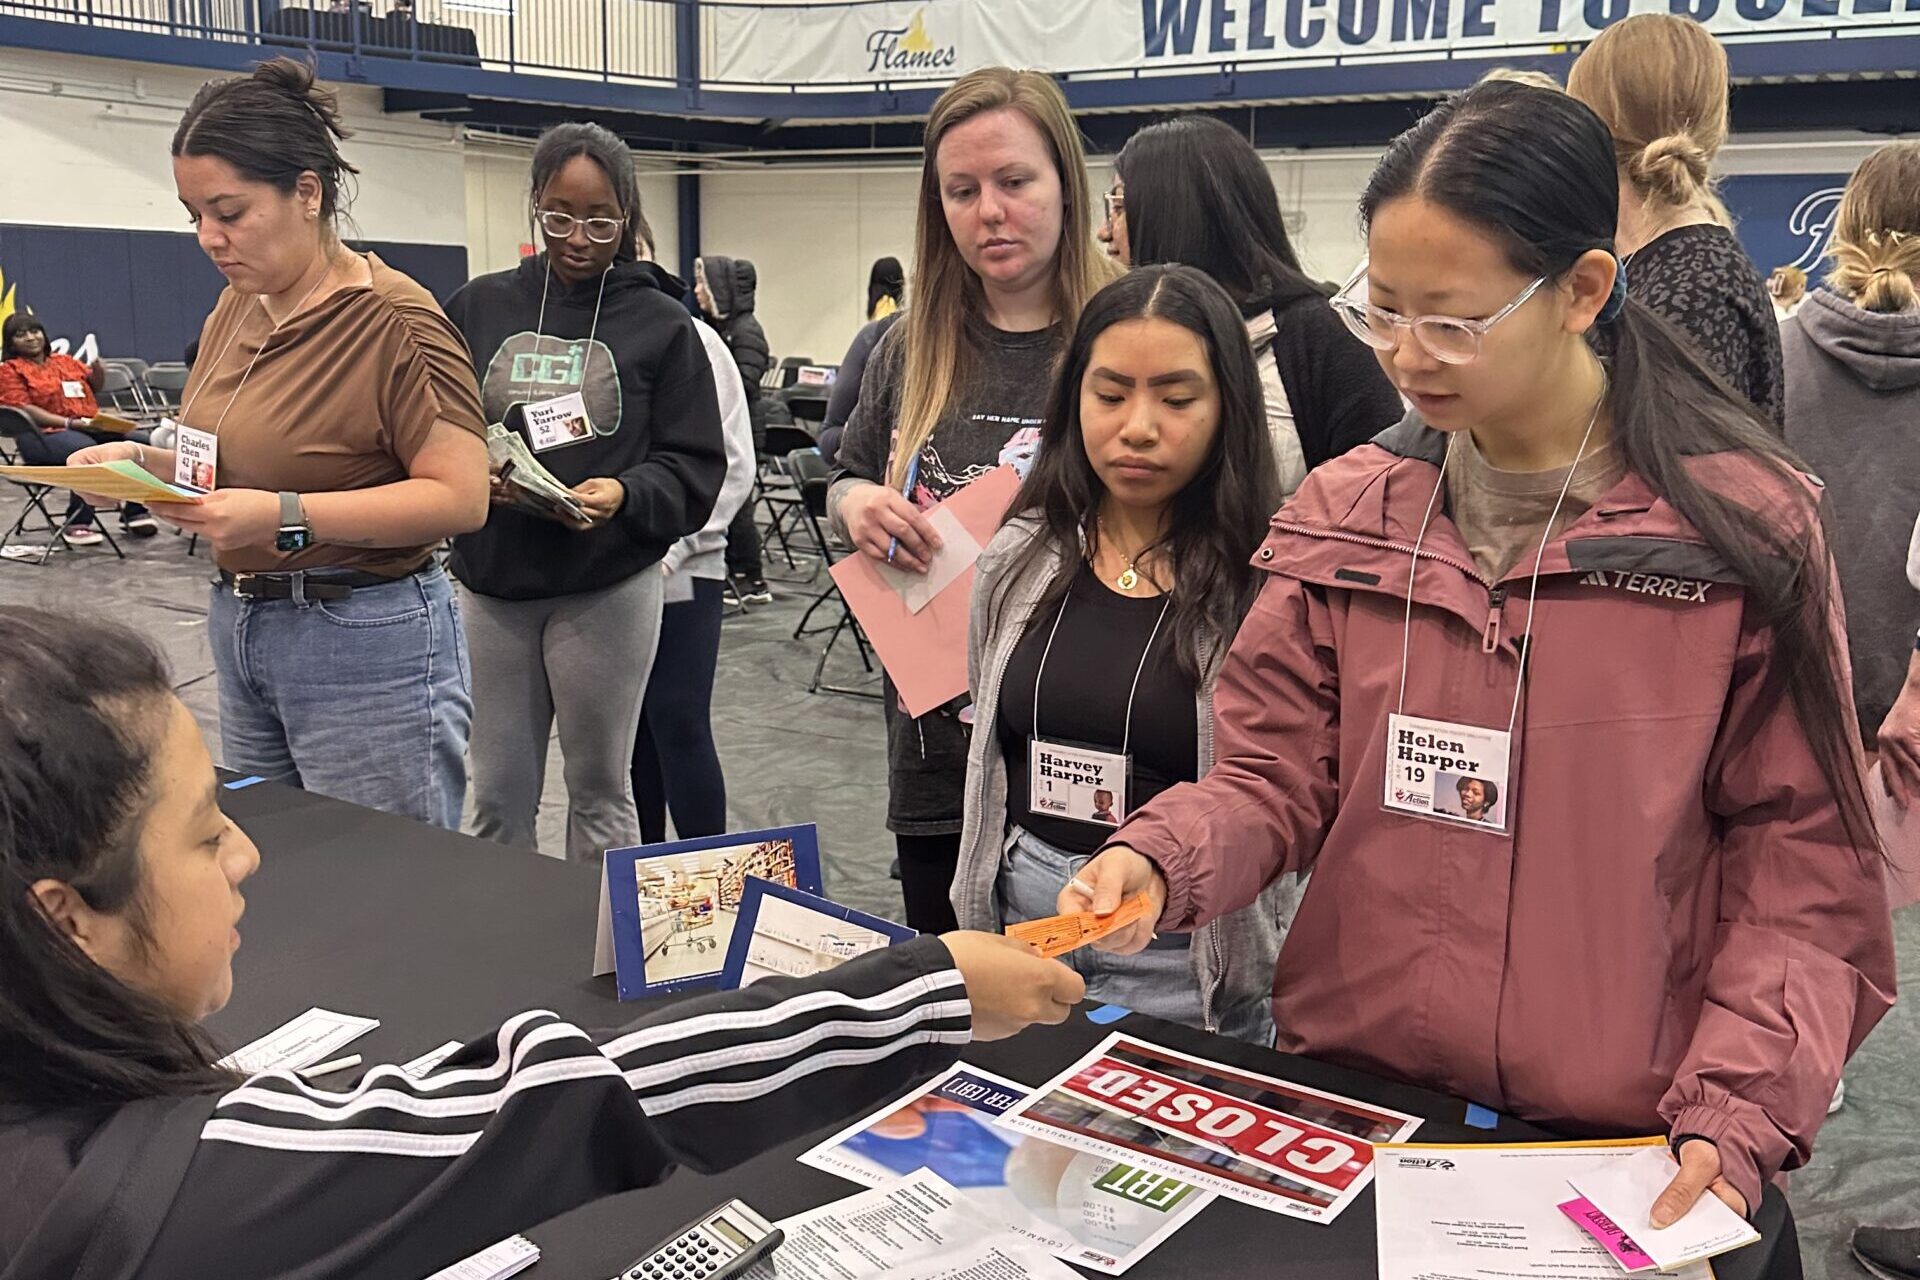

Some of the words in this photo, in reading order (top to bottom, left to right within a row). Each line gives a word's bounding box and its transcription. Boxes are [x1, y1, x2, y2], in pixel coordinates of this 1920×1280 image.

[1142, 0, 1496, 58] WELCOME
[866, 26, 957, 72] Flames
[531, 407, 554, 419] Yuri
[532, 411, 572, 426] Yarrow
[539, 425, 551, 435] 52
[181, 434, 210, 451] Charles
[181, 444, 200, 458] Chen
[1614, 570, 1713, 602] TERREX
[1398, 729, 1465, 754] Helen
[1040, 752, 1103, 776] Harvey
[1397, 745, 1480, 773] Harper
[1040, 764, 1104, 786] Harper
[1046, 780, 1052, 792] 1
[1405, 766, 1425, 783] 19
[942, 1078, 992, 1102] (EBT)
[1009, 1118, 1078, 1143] SIMULATION
[1087, 1069, 1355, 1174] CLOSED
[1084, 1142, 1135, 1161] POVERTY
[1140, 1158, 1185, 1175] ACTION
[1191, 1174, 1268, 1201] COMMUNITY
